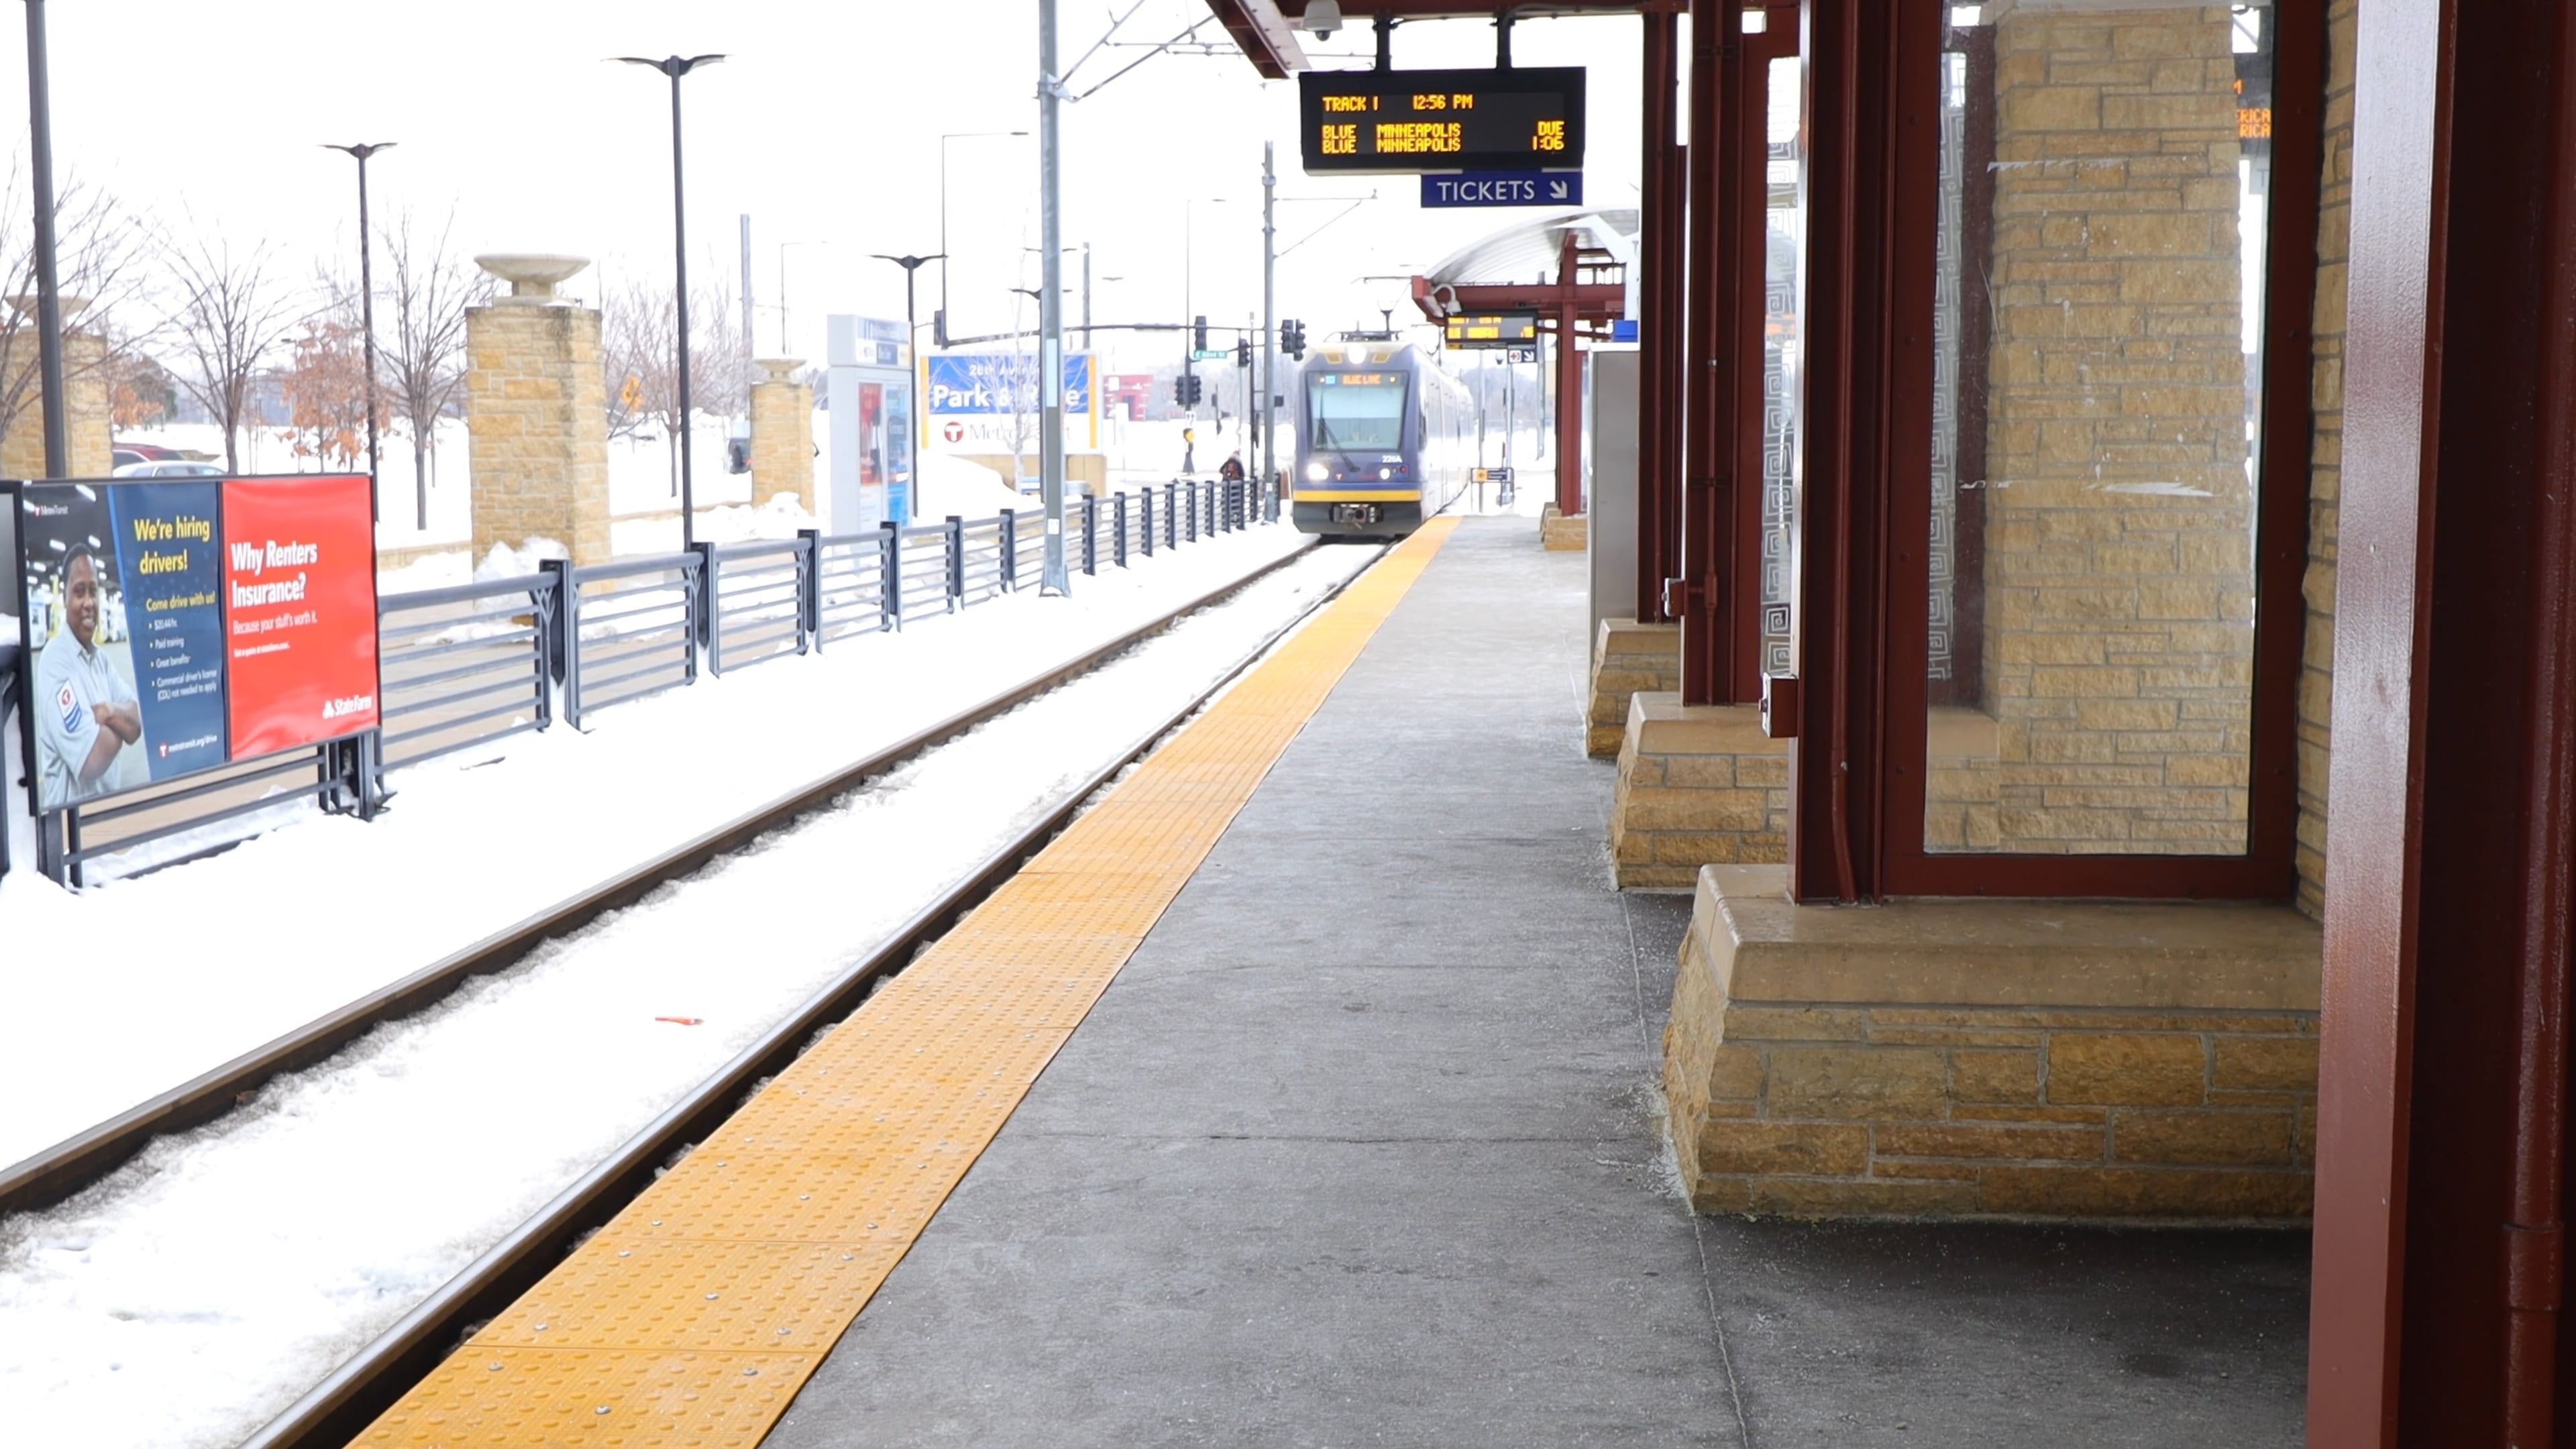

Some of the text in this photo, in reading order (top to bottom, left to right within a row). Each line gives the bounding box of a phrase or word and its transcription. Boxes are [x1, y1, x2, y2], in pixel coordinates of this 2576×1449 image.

[1322, 94, 1473, 112] TRACK 1 12:56 PM
[1322, 121, 1565, 140] BLUE MINNEAPOLIS DUE
[1322, 136, 1565, 154] BLUE MINNEAPOLIS 1:06
[1436, 180, 1536, 202] TICKETS
[933, 383, 990, 408] Park
[134, 515, 210, 543] We're hiring
[140, 548, 188, 575] drivers!
[231, 539, 318, 576] Why Renters
[146, 590, 215, 612] Come drive with us!
[232, 572, 307, 608] Insurance?
[233, 620, 260, 635] Because
[260, 618, 274, 634] your
[274, 612, 294, 629] stuff's
[294, 610, 311, 627] worth
[155, 636, 184, 649] Paid training
[156, 657, 170, 669] Great
[157, 673, 184, 688] Commercial
[180, 683, 198, 696] needed
[204, 680, 217, 694] apply
